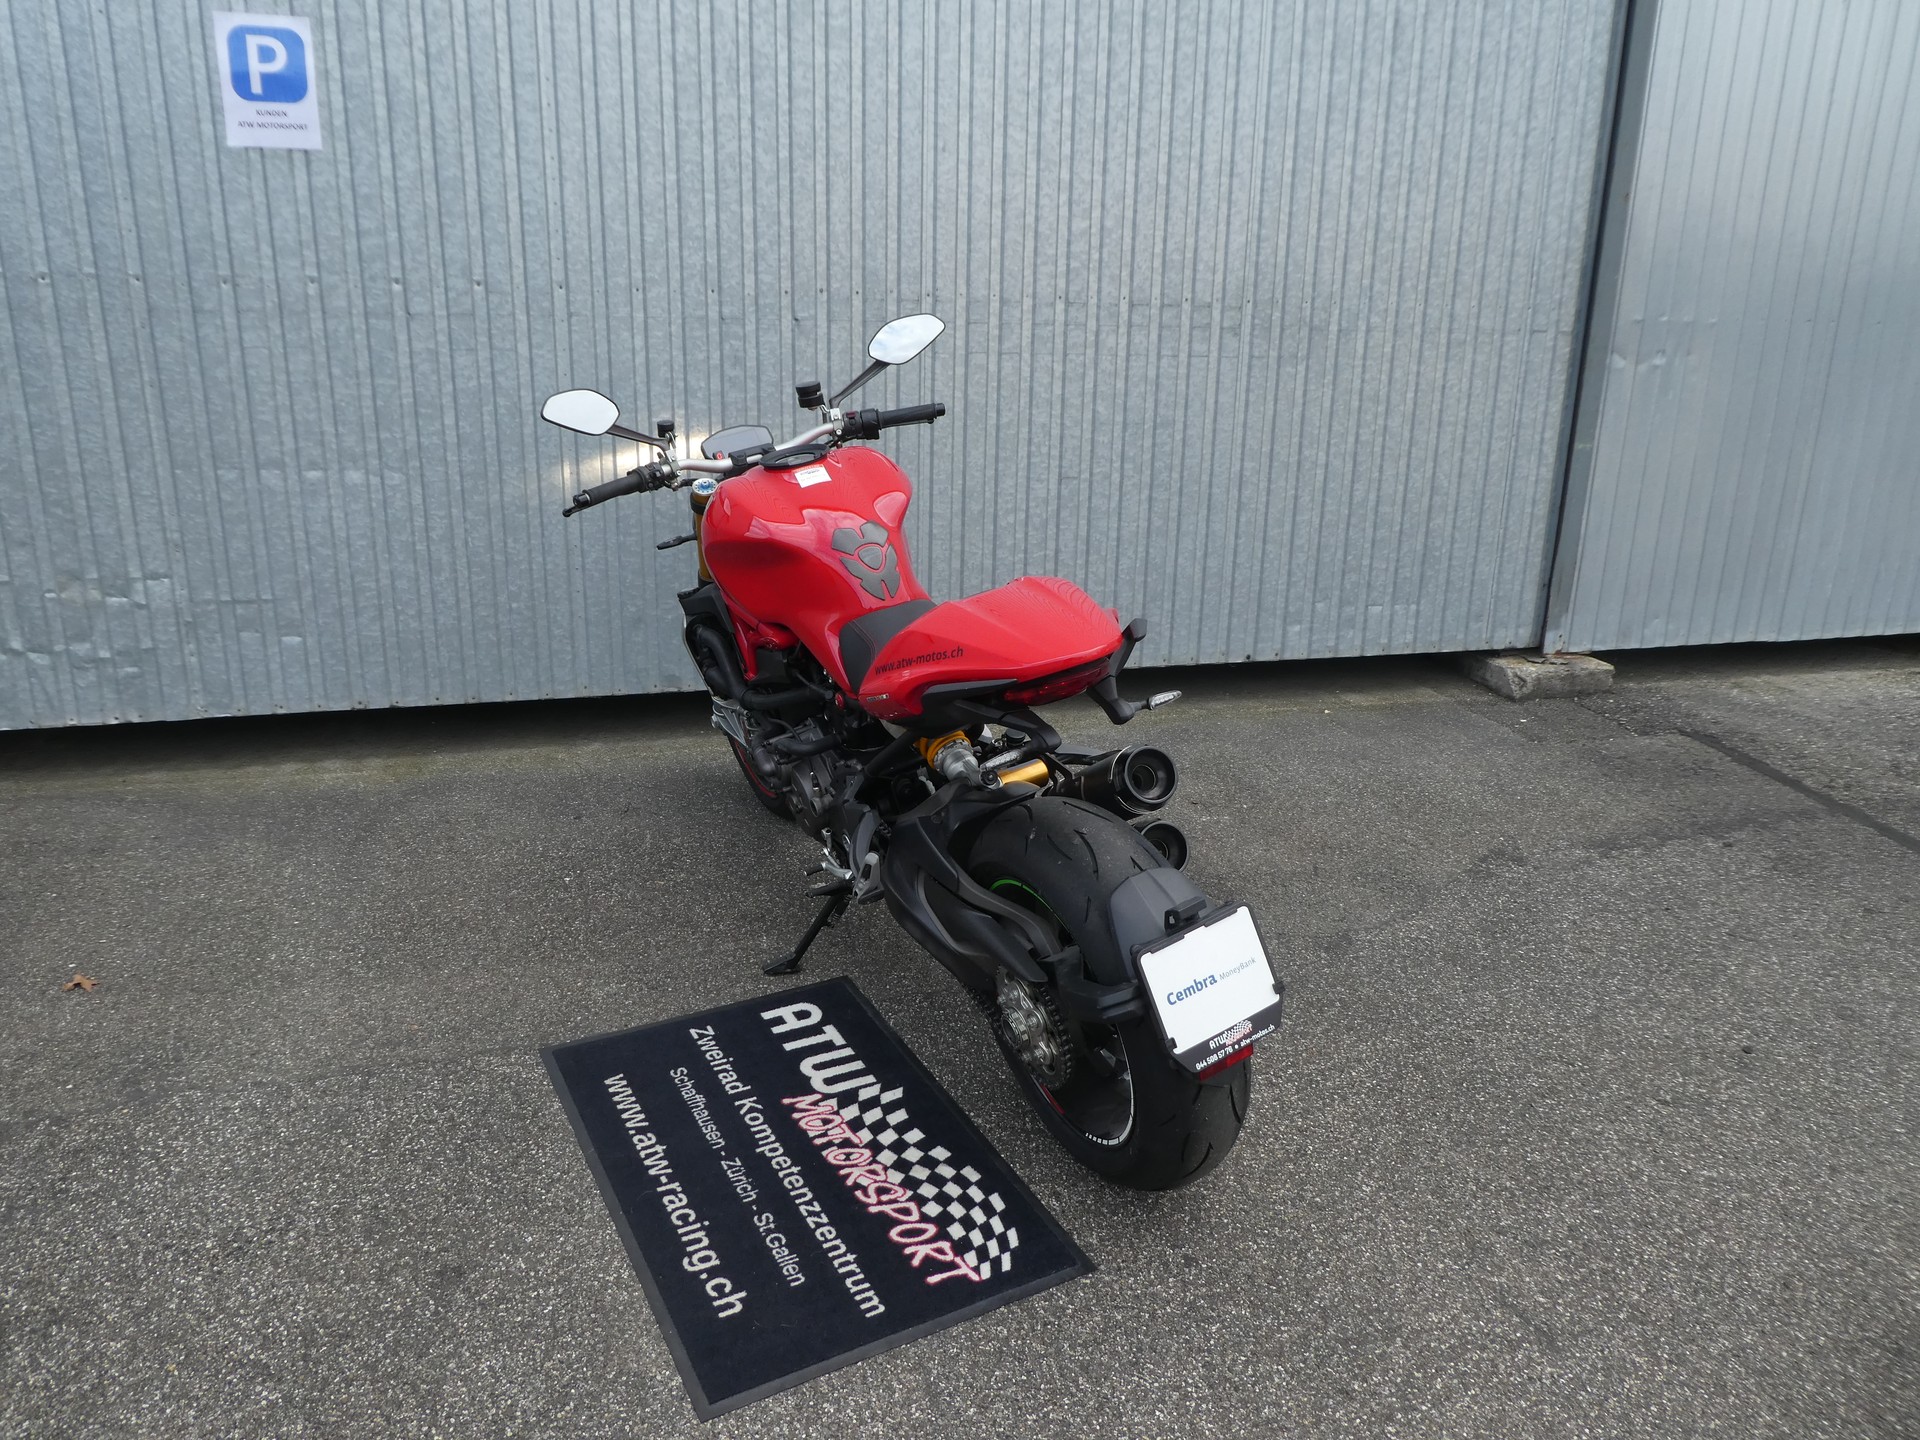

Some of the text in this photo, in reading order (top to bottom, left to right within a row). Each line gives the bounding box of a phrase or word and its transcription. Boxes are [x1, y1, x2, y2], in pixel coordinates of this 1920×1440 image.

[245, 34, 288, 95] P
[257, 122, 308, 130] MOTORSPORT
[875, 646, 964, 676] www.atw-motos.ch
[1167, 957, 1256, 1006] Cembra MoneyBank
[760, 1001, 877, 1095] ATW
[1196, 1060, 1207, 1070] 044
[1218, 1050, 1226, 1058] 57
[1240, 1023, 1275, 1046] atw-motos.ch
[1209, 1030, 1227, 1050] ATW
[603, 1073, 748, 1319] www.atw-racing.ch
[669, 1066, 728, 1150] Schaffhausen
[721, 1156, 757, 1203] Zürich
[753, 1212, 805, 1287] St.Gallen
[689, 1024, 886, 1319] Zweirad Kompetenzzentrum
[780, 1093, 985, 1285] MOTORSPORT
